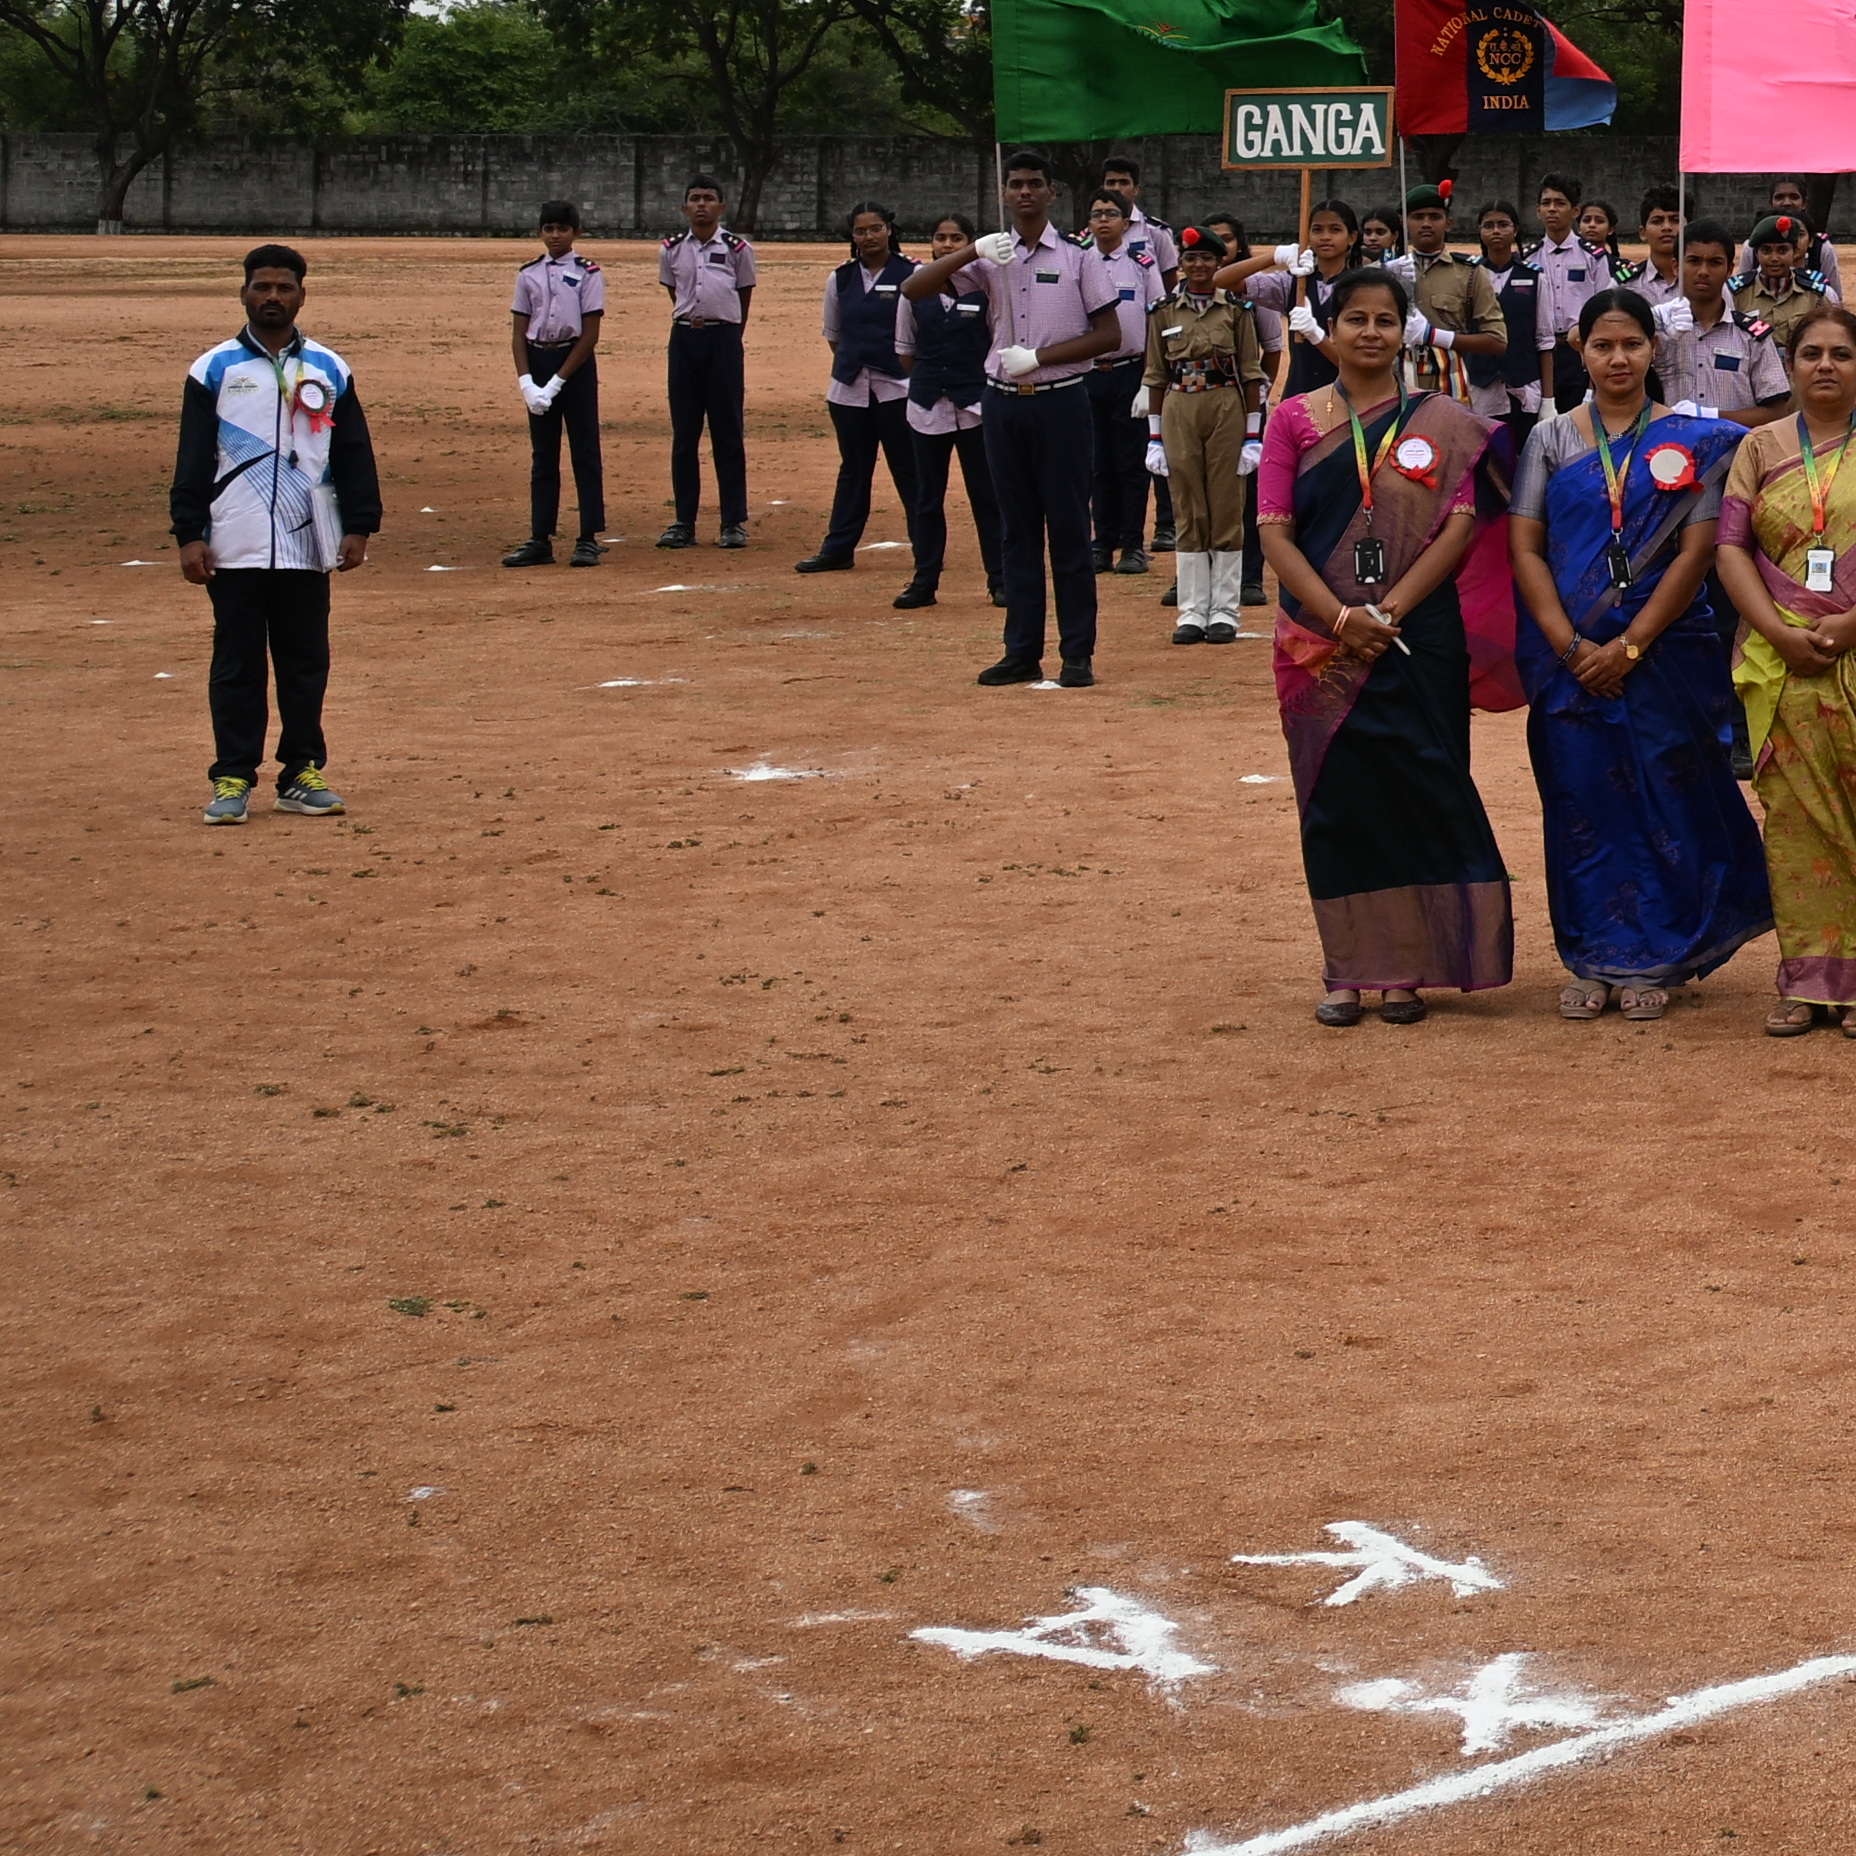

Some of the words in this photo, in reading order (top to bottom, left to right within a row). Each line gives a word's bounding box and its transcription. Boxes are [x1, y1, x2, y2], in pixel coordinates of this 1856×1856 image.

[1431, 8, 1488, 57] NATIONAL
[1493, 7, 1541, 28] CADET
[1489, 53, 1522, 65] NCC
[1482, 95, 1530, 110] INDIA
[1236, 103, 1386, 159] GANGA
